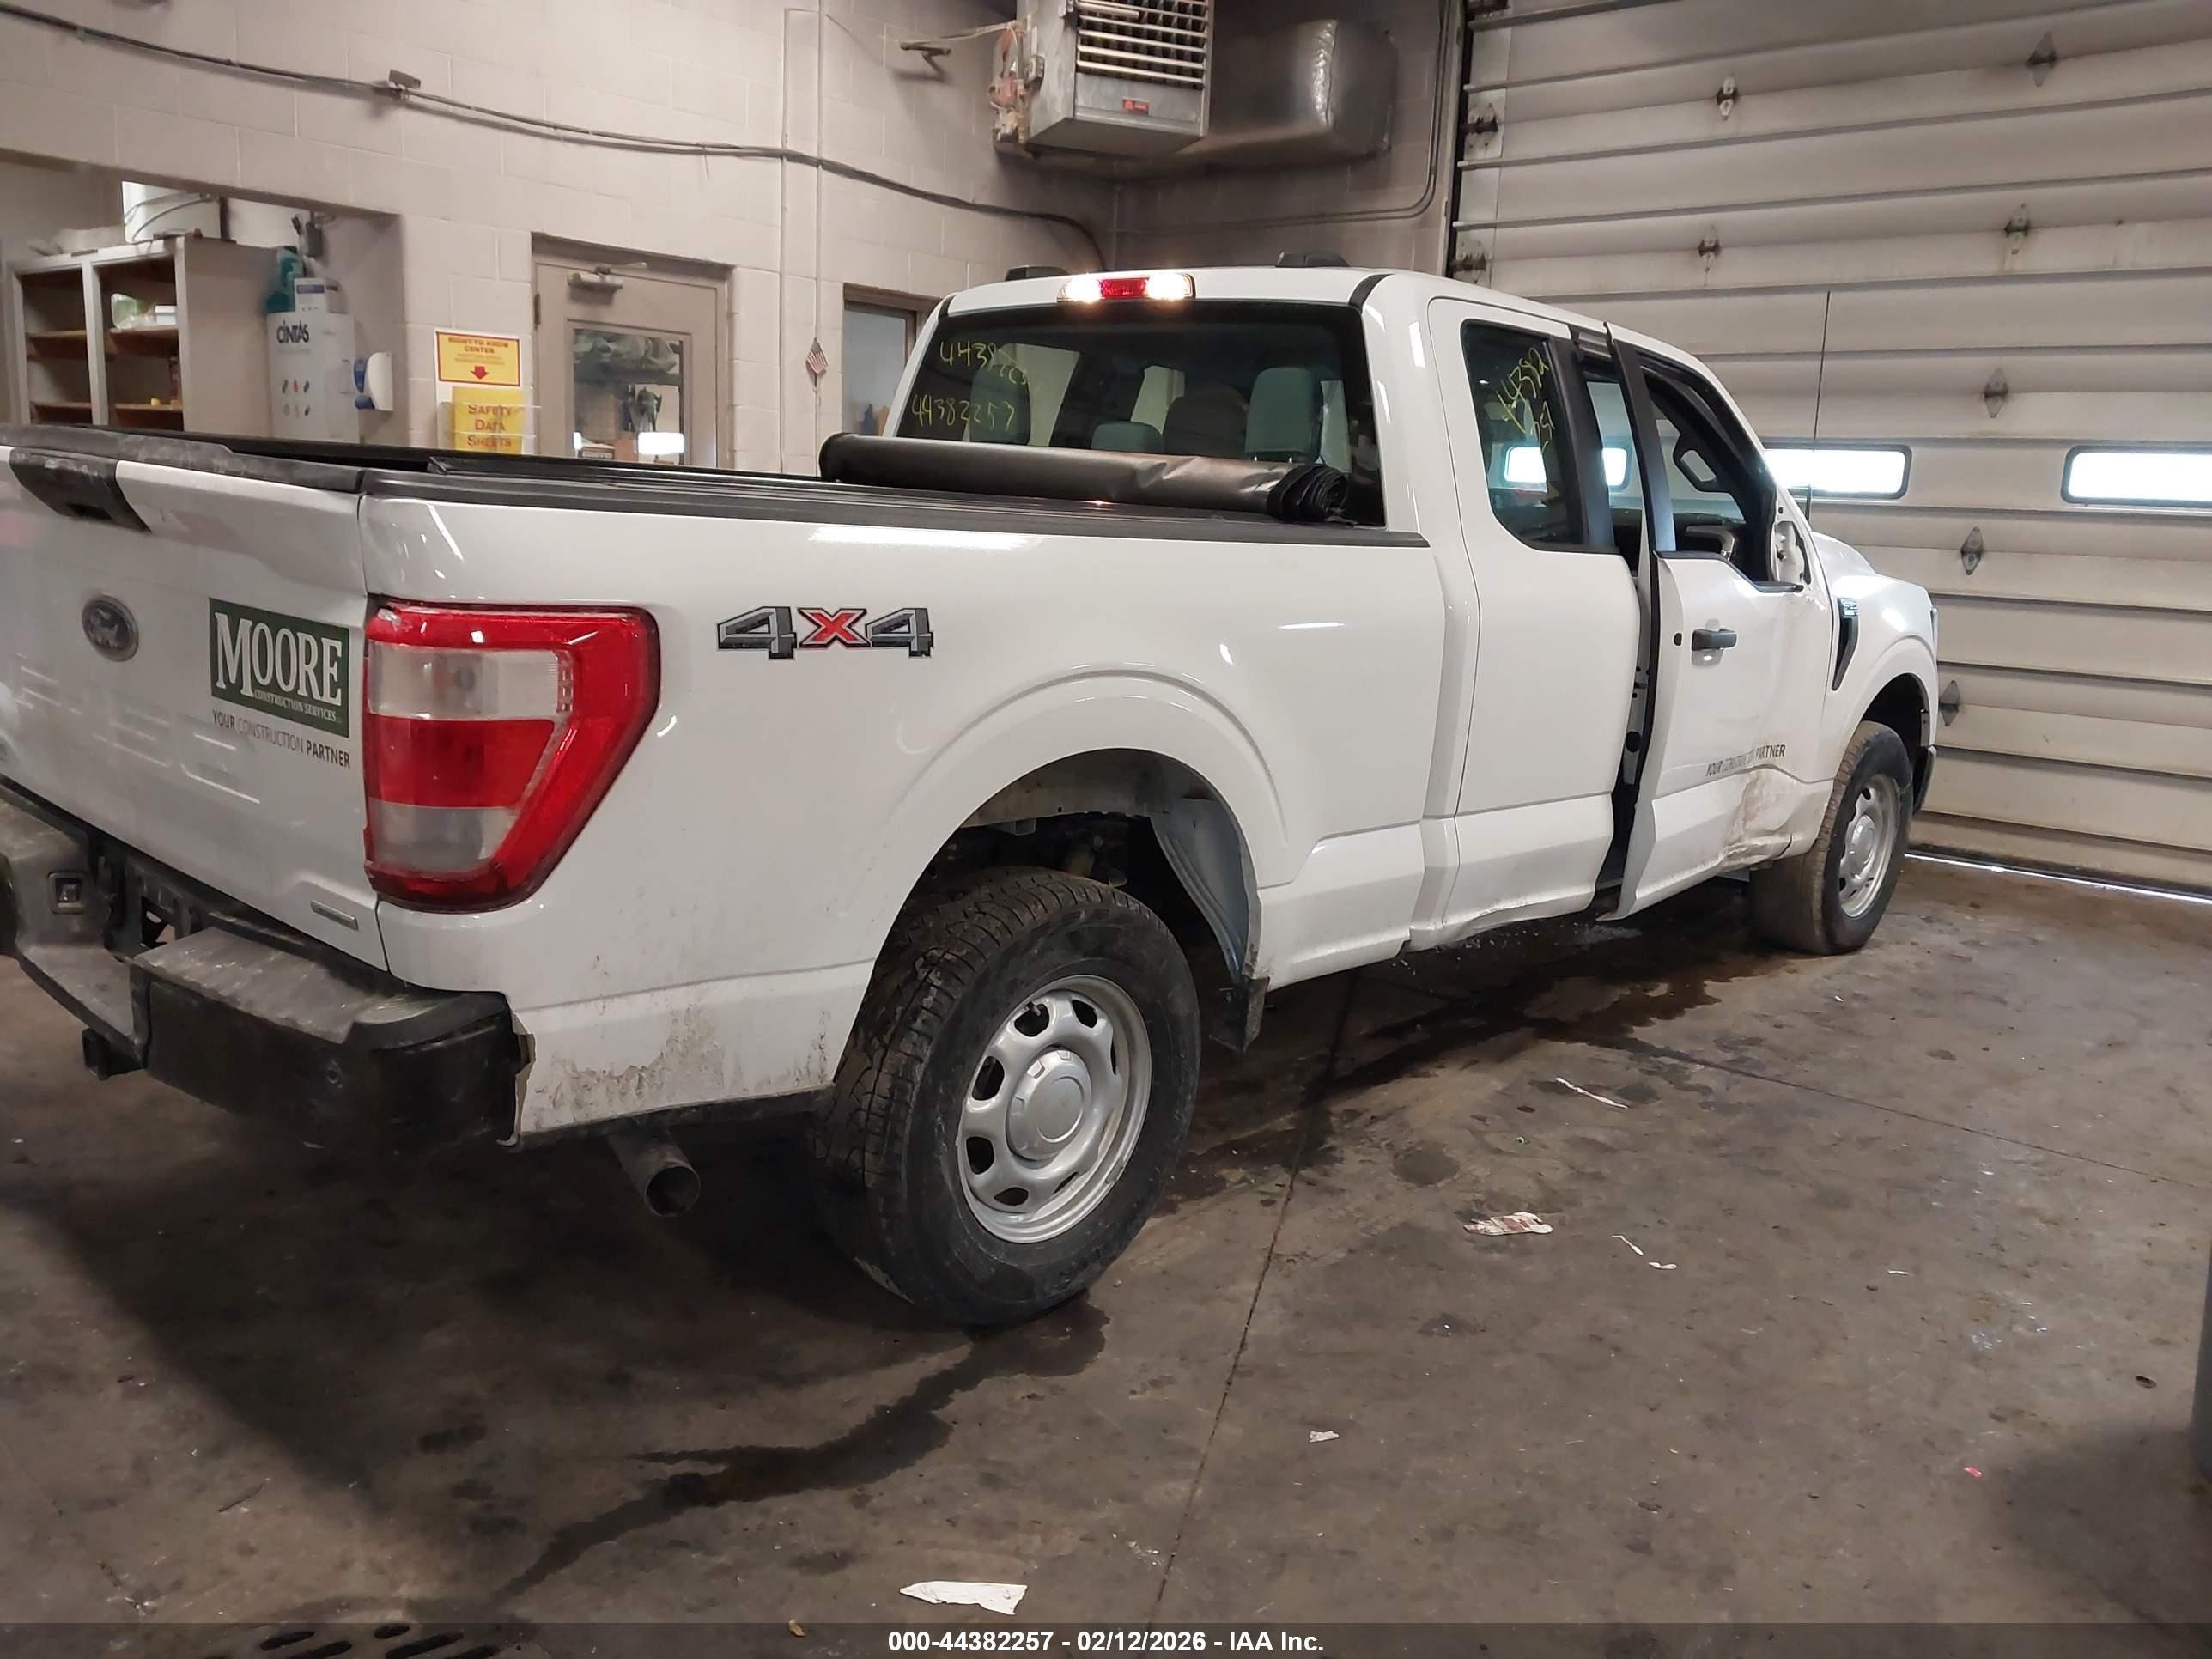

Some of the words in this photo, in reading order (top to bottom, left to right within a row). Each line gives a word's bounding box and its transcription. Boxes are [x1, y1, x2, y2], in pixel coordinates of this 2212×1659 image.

[475, 419, 506, 431] DATA
[911, 393, 1016, 432] 44382257
[717, 606, 934, 660] 4X4
[215, 611, 343, 707] MOORE
[253, 689, 304, 714] CONSTRUCTION
[304, 700, 337, 723] SERVICES
[214, 709, 236, 731] YOUR
[236, 717, 304, 753] CONSTRUCTION
[307, 740, 351, 769] PARTNER
